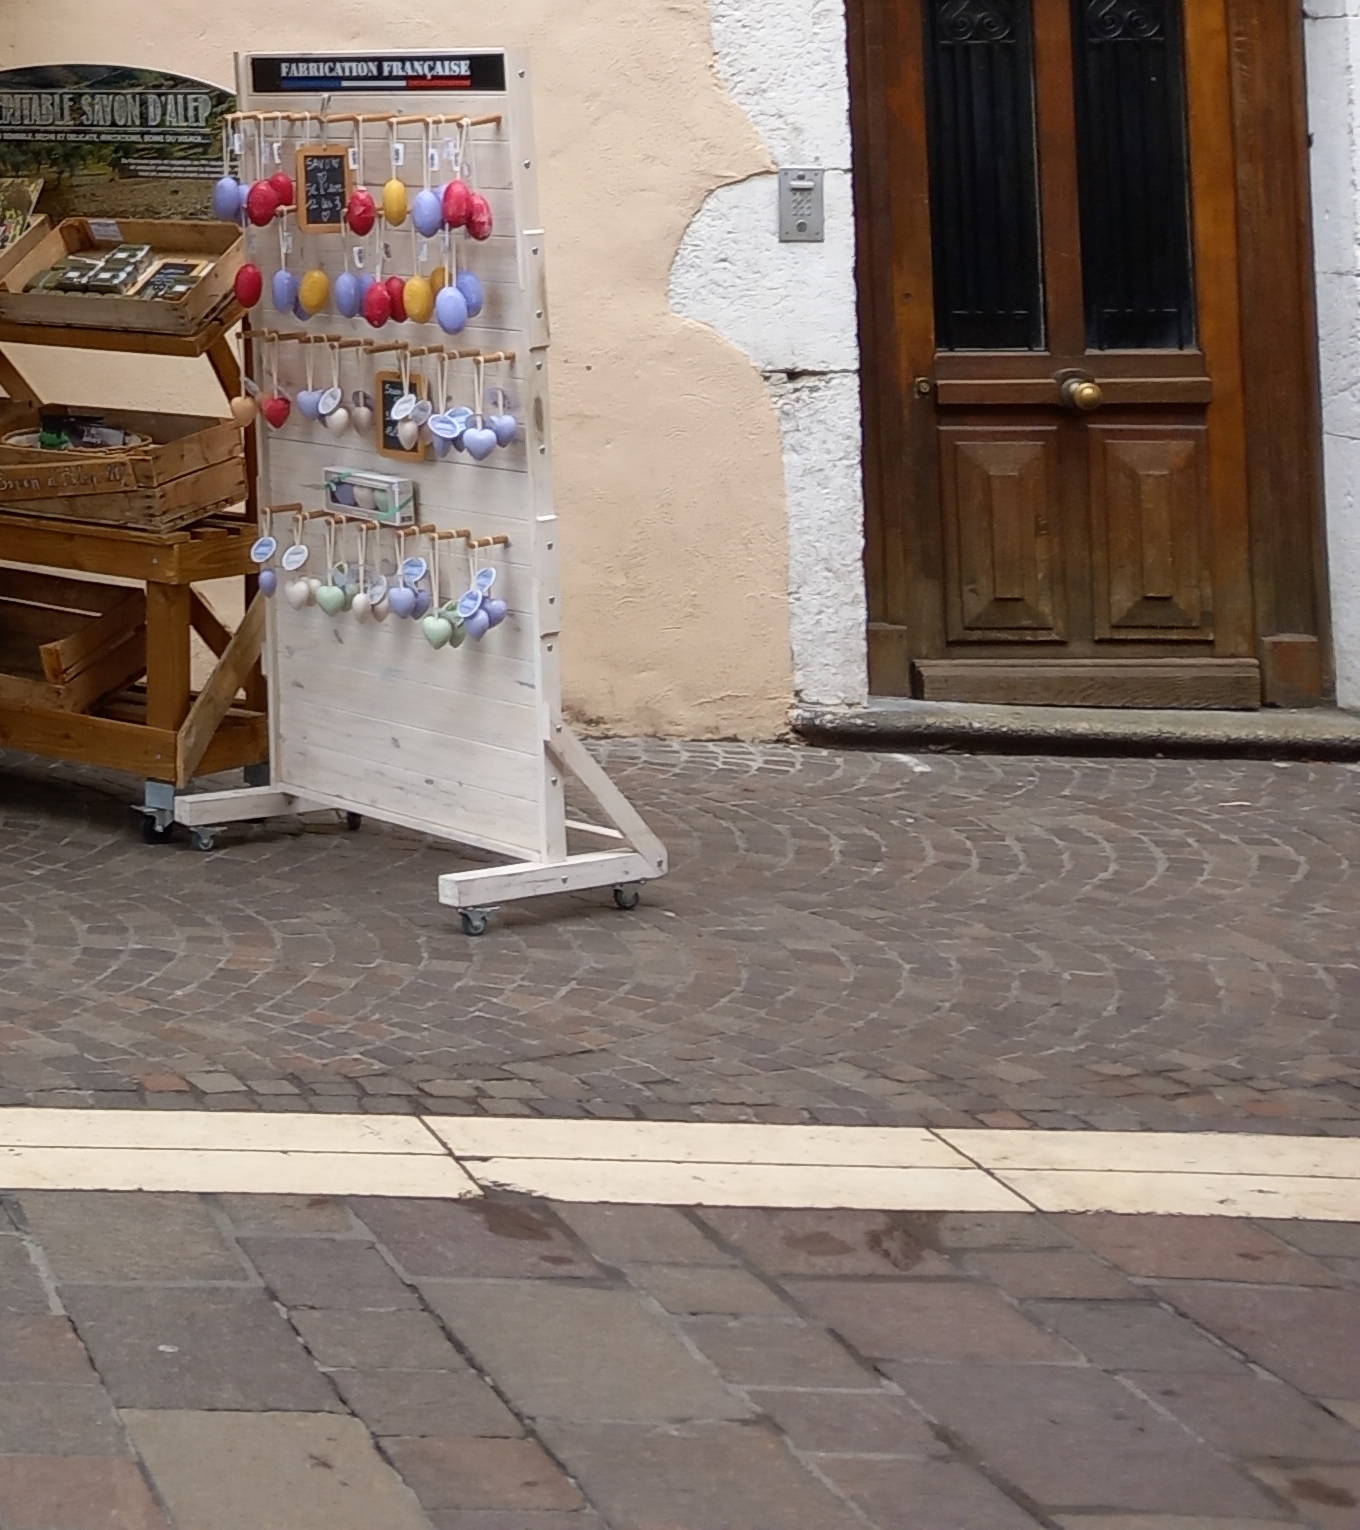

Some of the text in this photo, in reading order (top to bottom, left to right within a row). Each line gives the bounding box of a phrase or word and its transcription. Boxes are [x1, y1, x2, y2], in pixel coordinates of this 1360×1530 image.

[280, 60, 471, 80] FABRICATION FRANÇAISE
[80, 94, 141, 126] SAVON
[146, 93, 212, 128] D'ALEP
